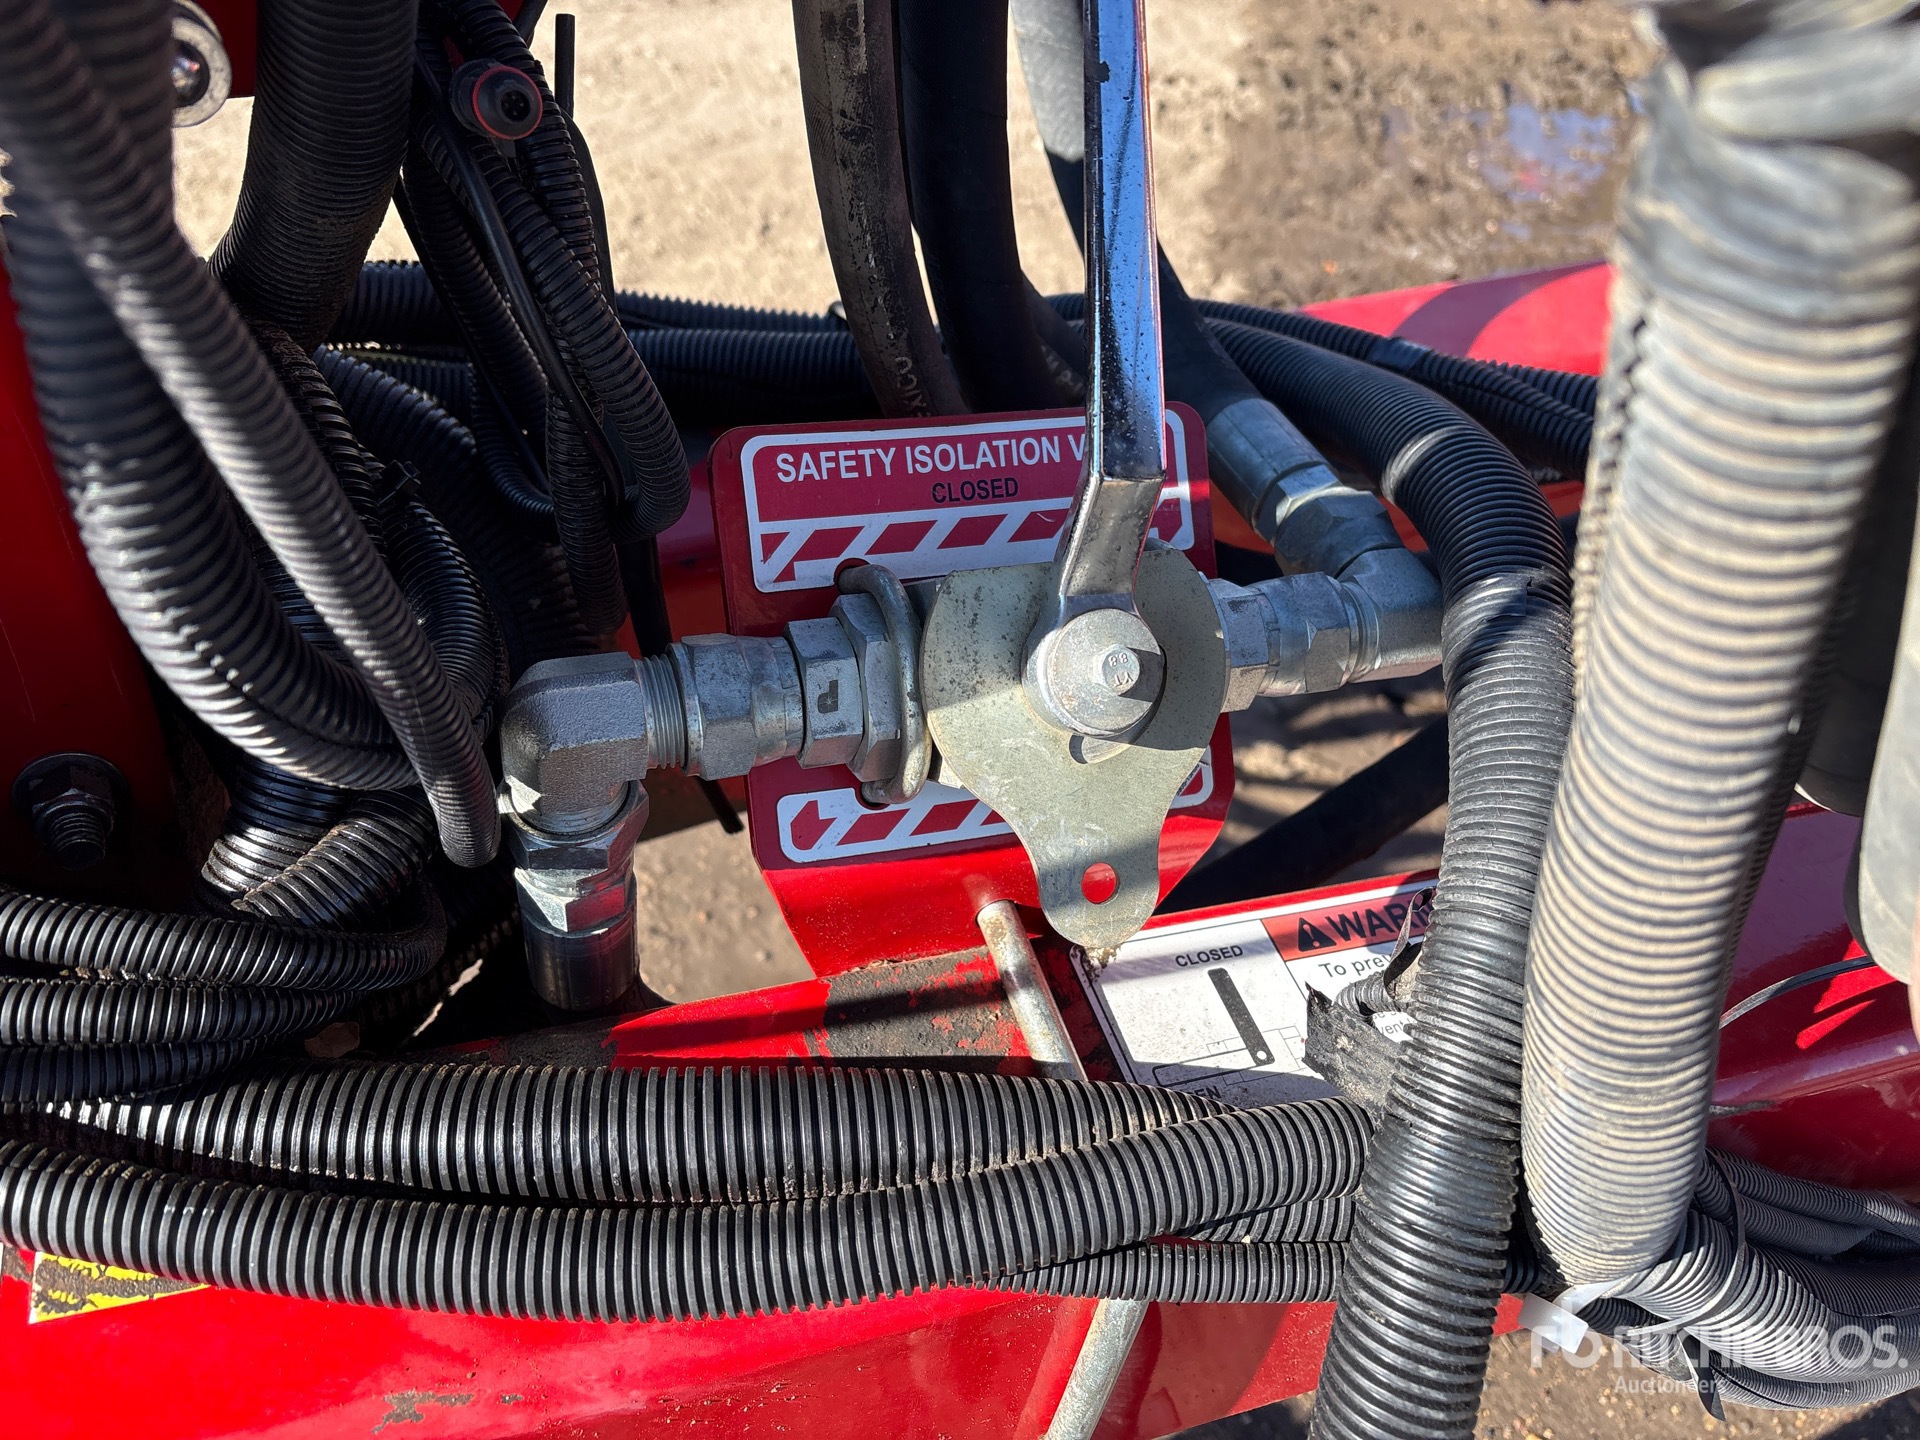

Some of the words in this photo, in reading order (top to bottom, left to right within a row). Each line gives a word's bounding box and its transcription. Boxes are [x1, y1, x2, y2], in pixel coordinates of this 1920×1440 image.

[776, 447, 896, 483] SAFETY
[905, 437, 1061, 474] ISOLATION
[931, 477, 1019, 504] CLOSED
[1175, 945, 1243, 967] CLOSED
[1318, 962, 1347, 977] To
